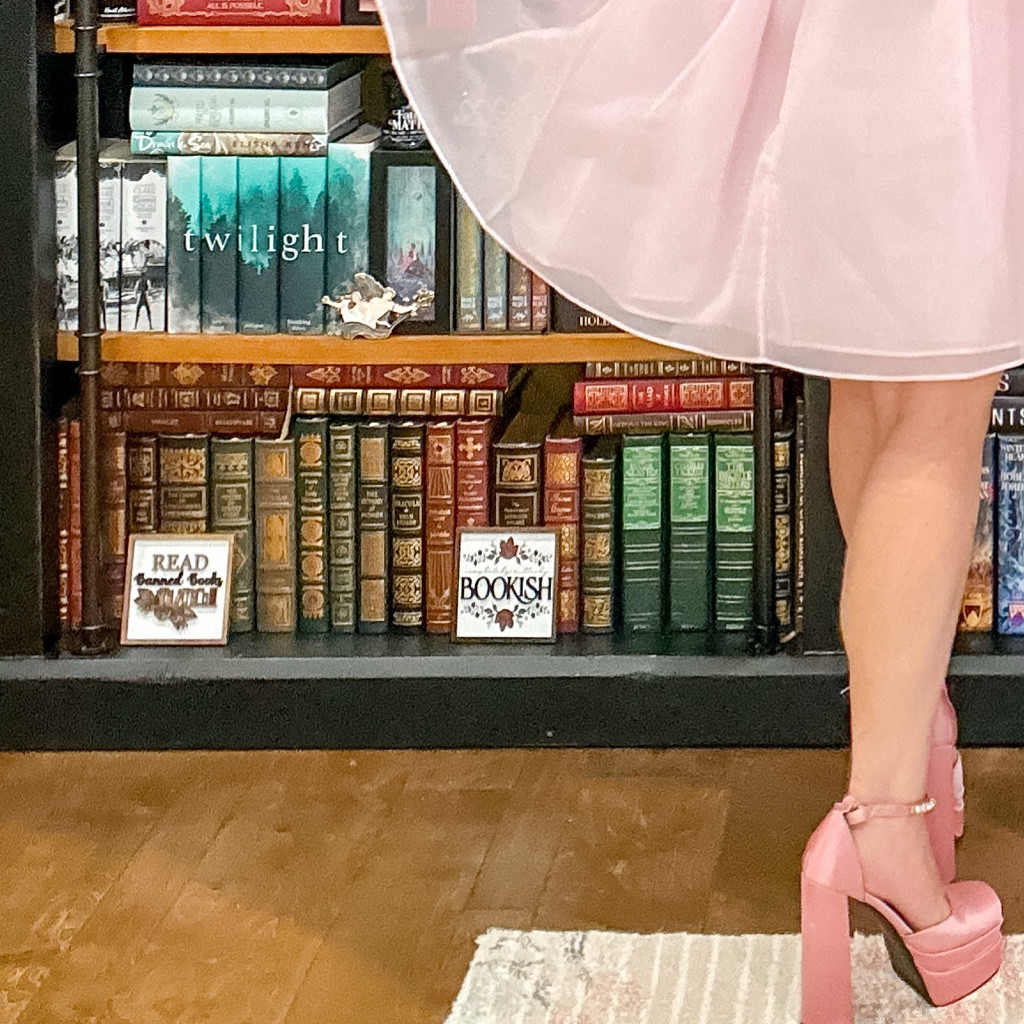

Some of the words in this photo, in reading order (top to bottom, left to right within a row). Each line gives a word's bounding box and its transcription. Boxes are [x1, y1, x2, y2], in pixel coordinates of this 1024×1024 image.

[207, 2, 220, 10] ALL
[183, 223, 348, 261] twilight
[151, 553, 209, 572] READ
[134, 571, 184, 587] Banned
[187, 575, 222, 588] Books
[461, 576, 552, 605] BOOKISH
